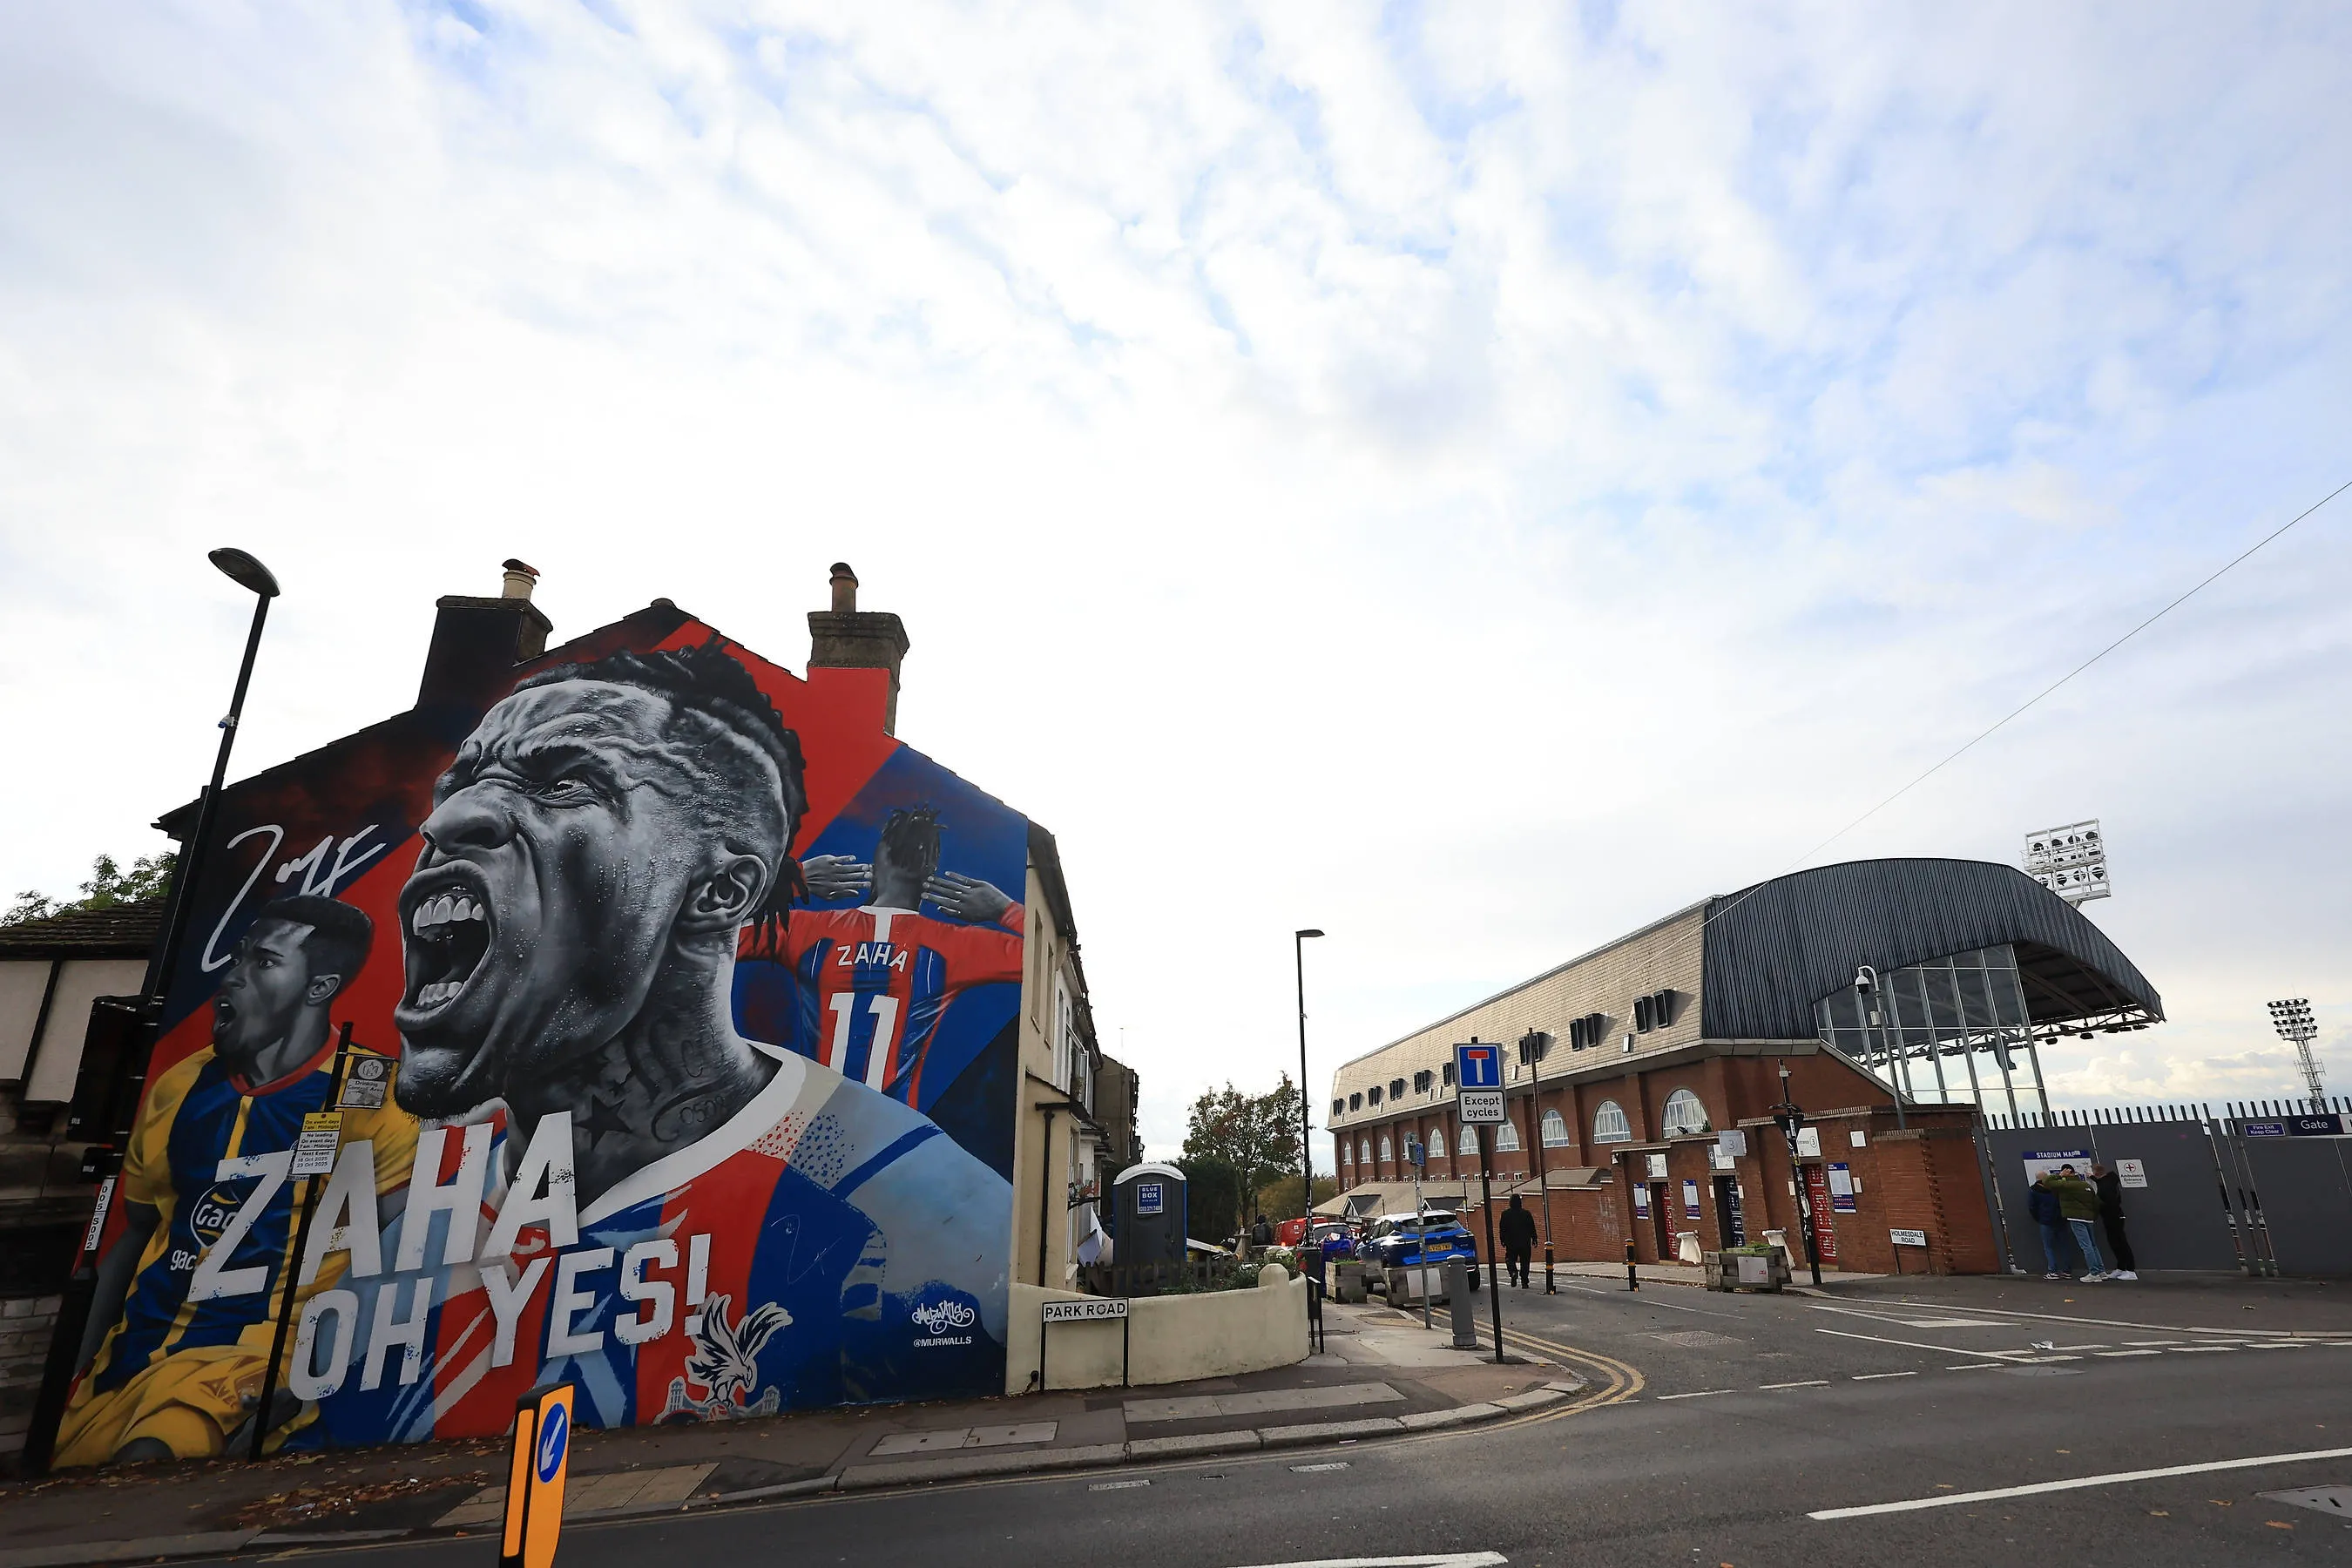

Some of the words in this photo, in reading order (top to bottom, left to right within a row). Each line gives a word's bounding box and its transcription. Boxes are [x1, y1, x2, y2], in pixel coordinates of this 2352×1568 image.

[837, 943, 909, 972] ZAHA
[828, 992, 899, 1093] 11
[1464, 1096, 1500, 1106] Except
[1467, 1107, 1498, 1119] cycles
[2301, 1119, 2328, 1130] Gate
[1728, 1139, 1735, 1150] 3
[187, 1111, 578, 1303] ZAHA
[289, 1277, 433, 1401] OH
[480, 1233, 711, 1368] YES!
[1045, 1305, 1082, 1318] PARK
[1086, 1302, 1125, 1315] ROAD
[914, 1336, 972, 1348] @MURWALLS
